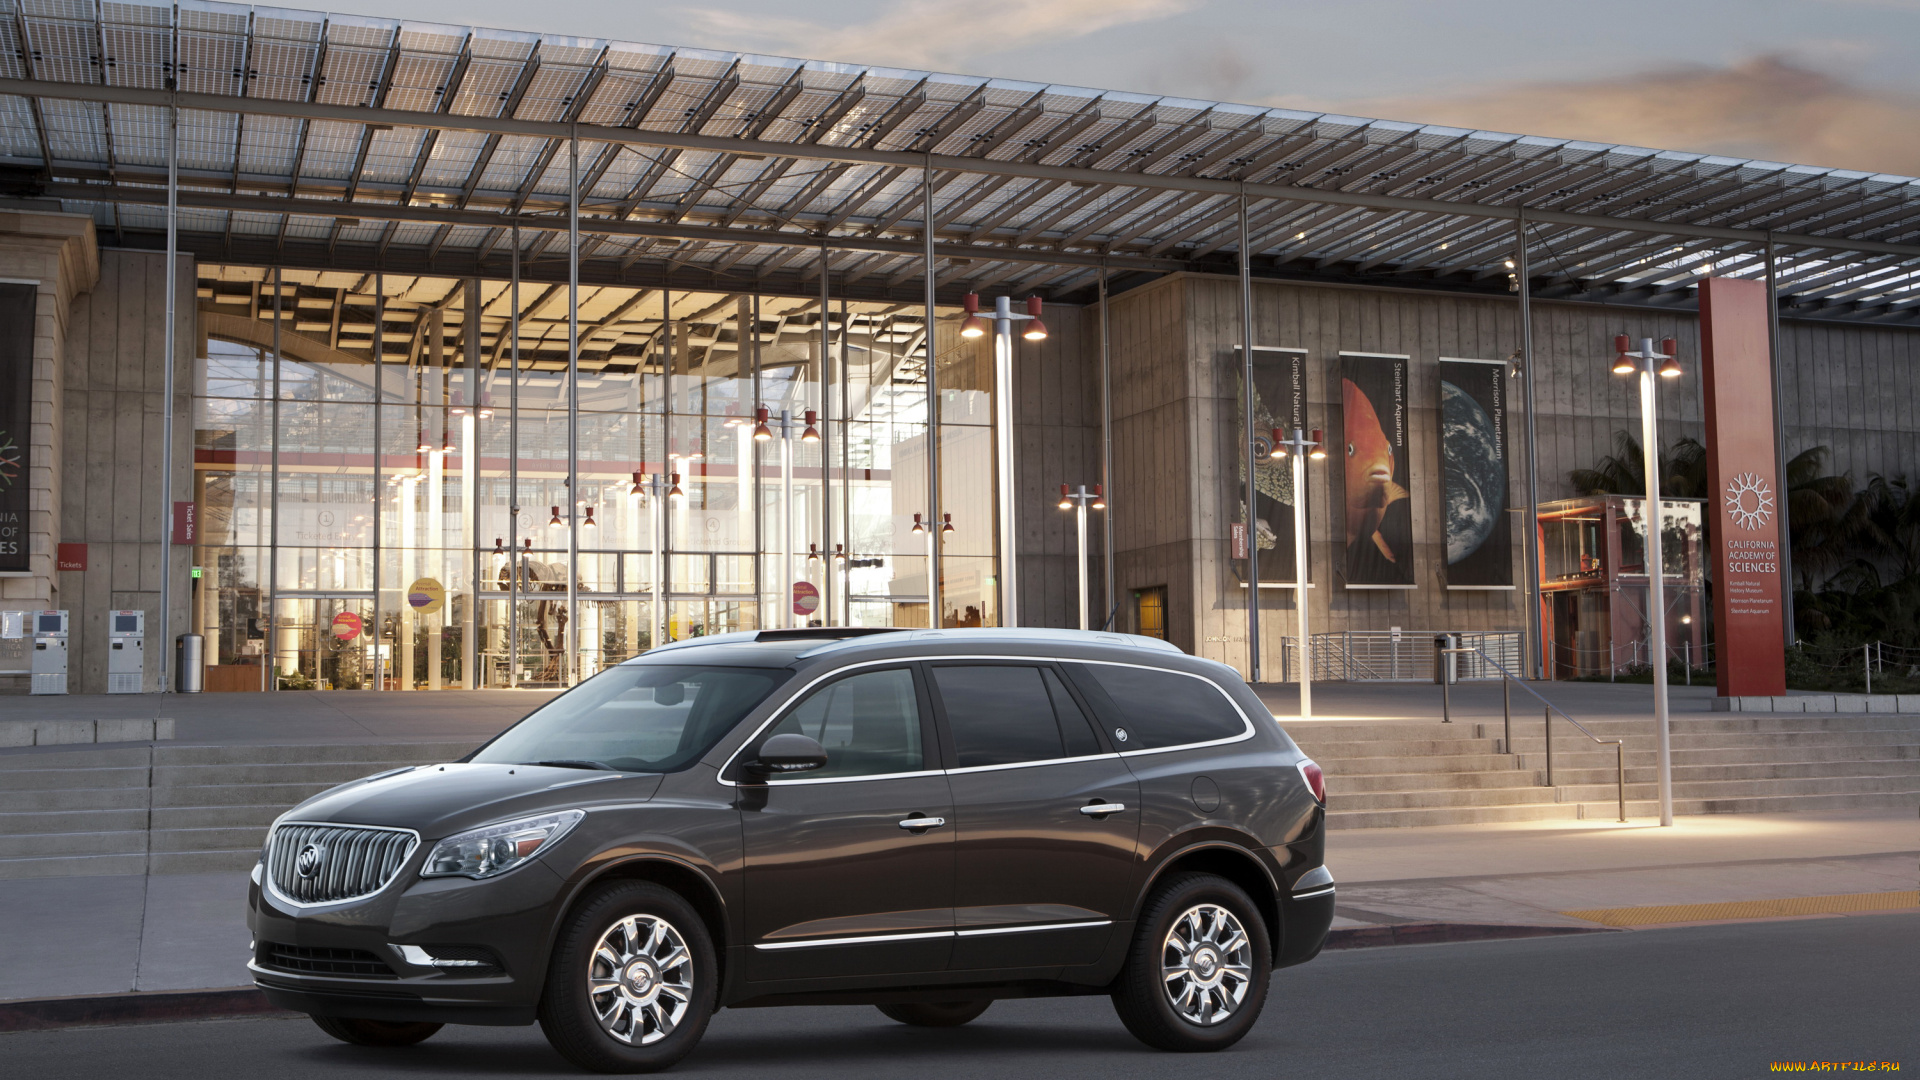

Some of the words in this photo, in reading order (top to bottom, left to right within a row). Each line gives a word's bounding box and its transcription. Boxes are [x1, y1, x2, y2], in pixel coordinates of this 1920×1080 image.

[1292, 356, 1301, 390] Kimball
[1394, 362, 1402, 402] Steinhart
[1492, 368, 1501, 407] Morrison
[1293, 391, 1302, 425] Natural
[1394, 403, 1403, 447] Aquarium
[1494, 408, 1503, 460] Planetarium
[186, 504, 194, 523] Ticket
[1, 526, 18, 537] OF
[186, 524, 194, 540] Sales
[1728, 540, 1775, 549] CALIFORNIA
[60, 561, 82, 569] Tickets
[1728, 551, 1764, 560] ACADEMY
[1765, 551, 1776, 560] OF
[1729, 562, 1776, 573] SCIENCES
